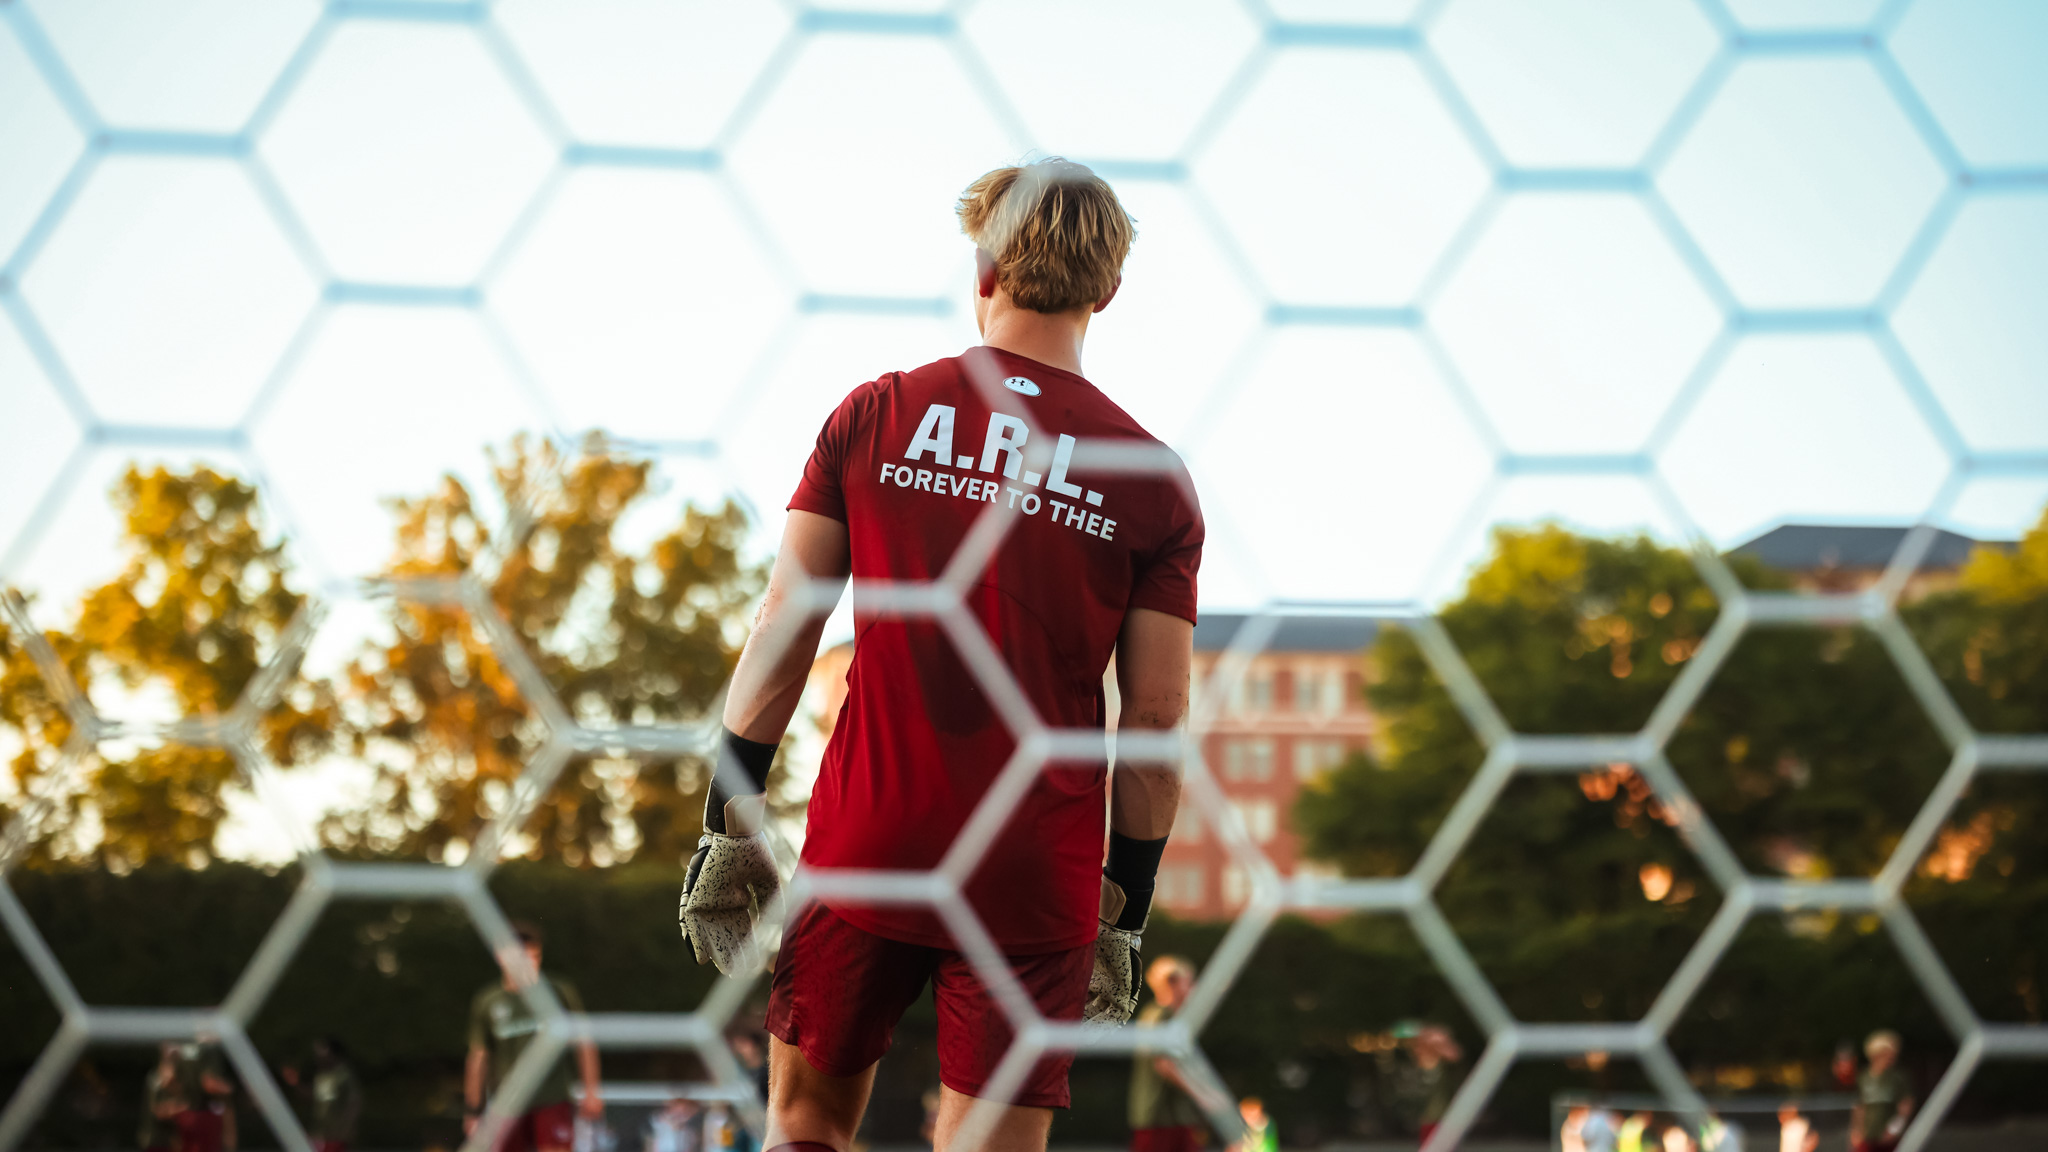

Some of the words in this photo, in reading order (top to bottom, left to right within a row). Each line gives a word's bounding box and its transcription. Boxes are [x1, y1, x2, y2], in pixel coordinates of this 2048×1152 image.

[904, 403, 1104, 507] A.R.L.
[879, 463, 999, 503] FOREVER
[1006, 486, 1042, 515] TO
[1049, 499, 1117, 541] THEE
